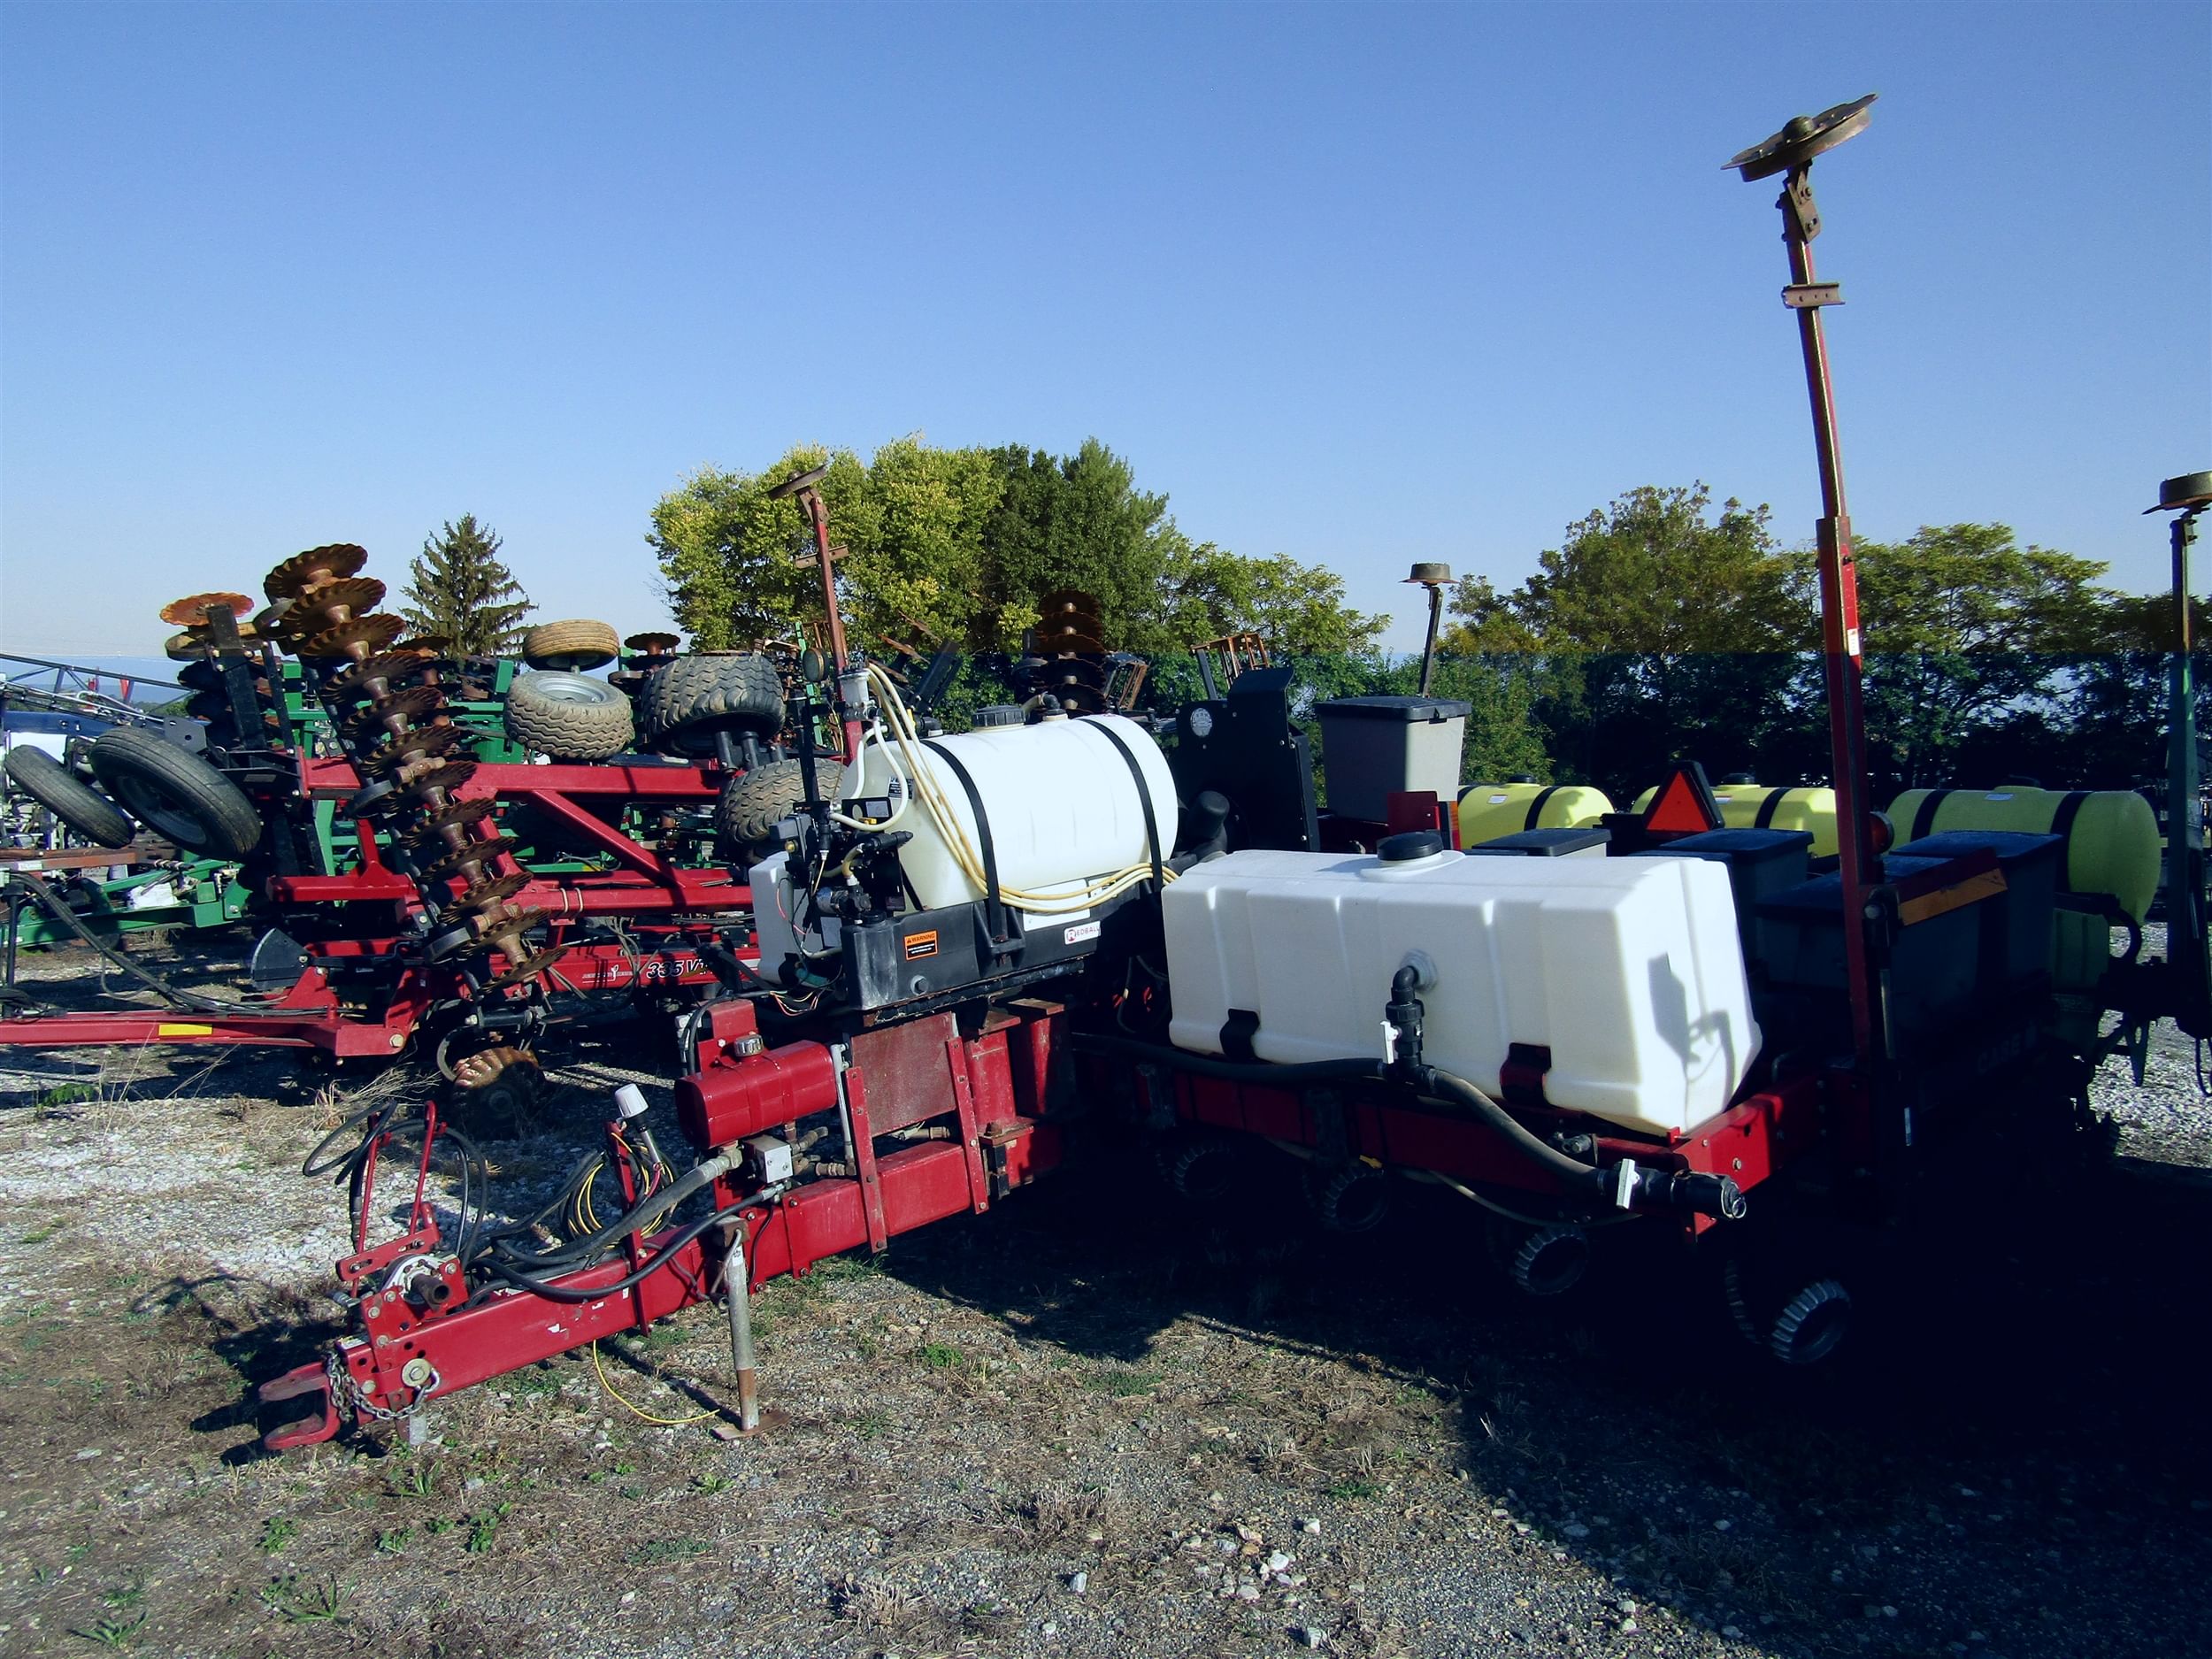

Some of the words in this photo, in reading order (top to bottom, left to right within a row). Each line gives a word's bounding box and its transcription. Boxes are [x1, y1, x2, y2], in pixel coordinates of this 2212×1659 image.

[911, 933, 935, 942] WARNING
[646, 960, 684, 979] 335
[1977, 1033, 2021, 1075] CASE
